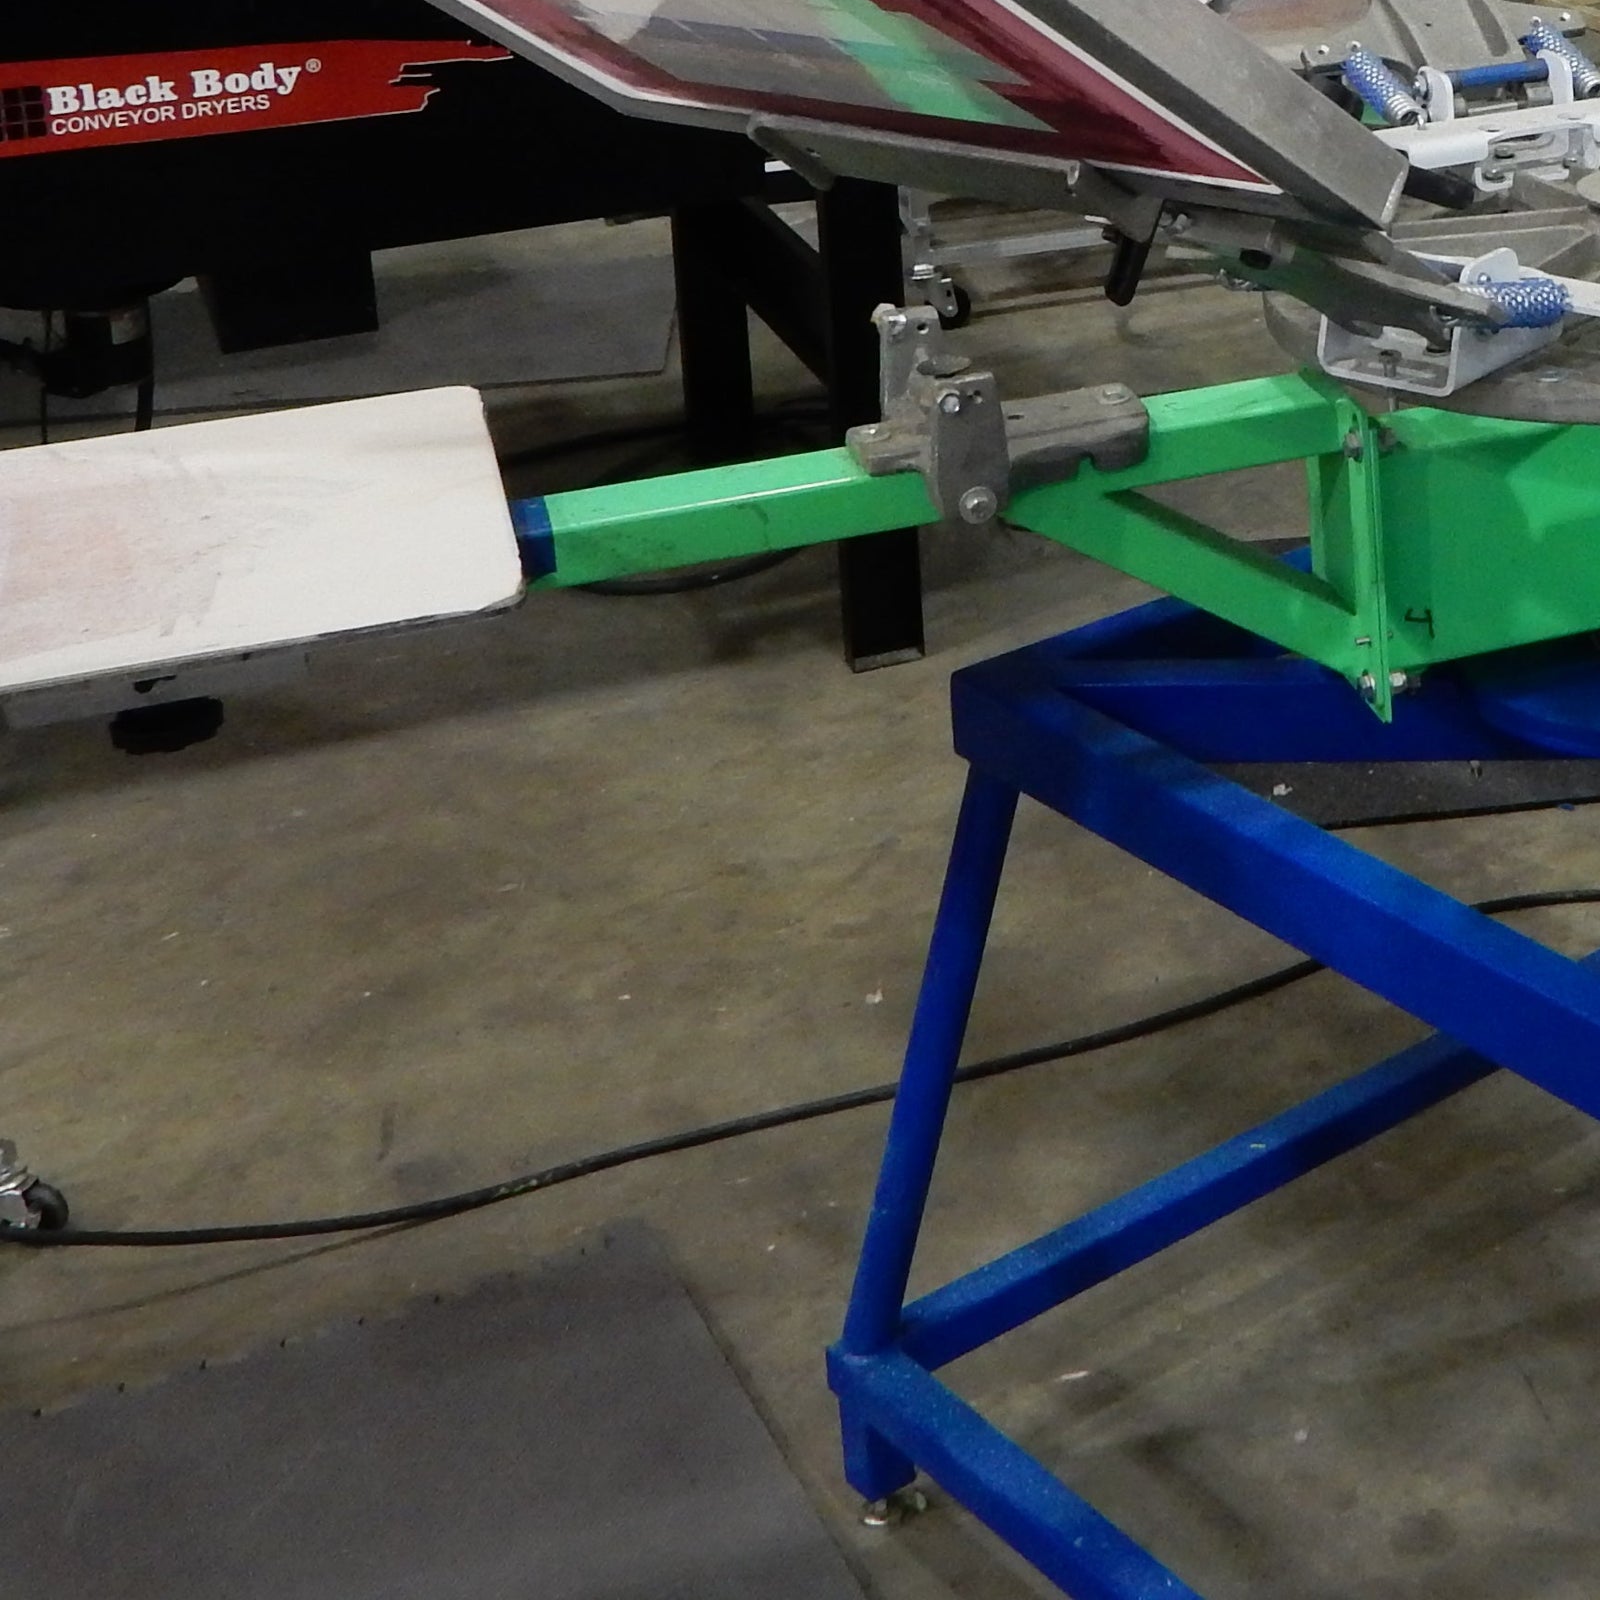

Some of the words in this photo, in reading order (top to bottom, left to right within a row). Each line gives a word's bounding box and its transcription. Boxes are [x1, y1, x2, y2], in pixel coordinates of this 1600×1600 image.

[48, 77, 179, 116] Black
[51, 104, 176, 136] CONVEYOR
[182, 93, 271, 120] DRYERS
[1404, 607, 1435, 640] 4
